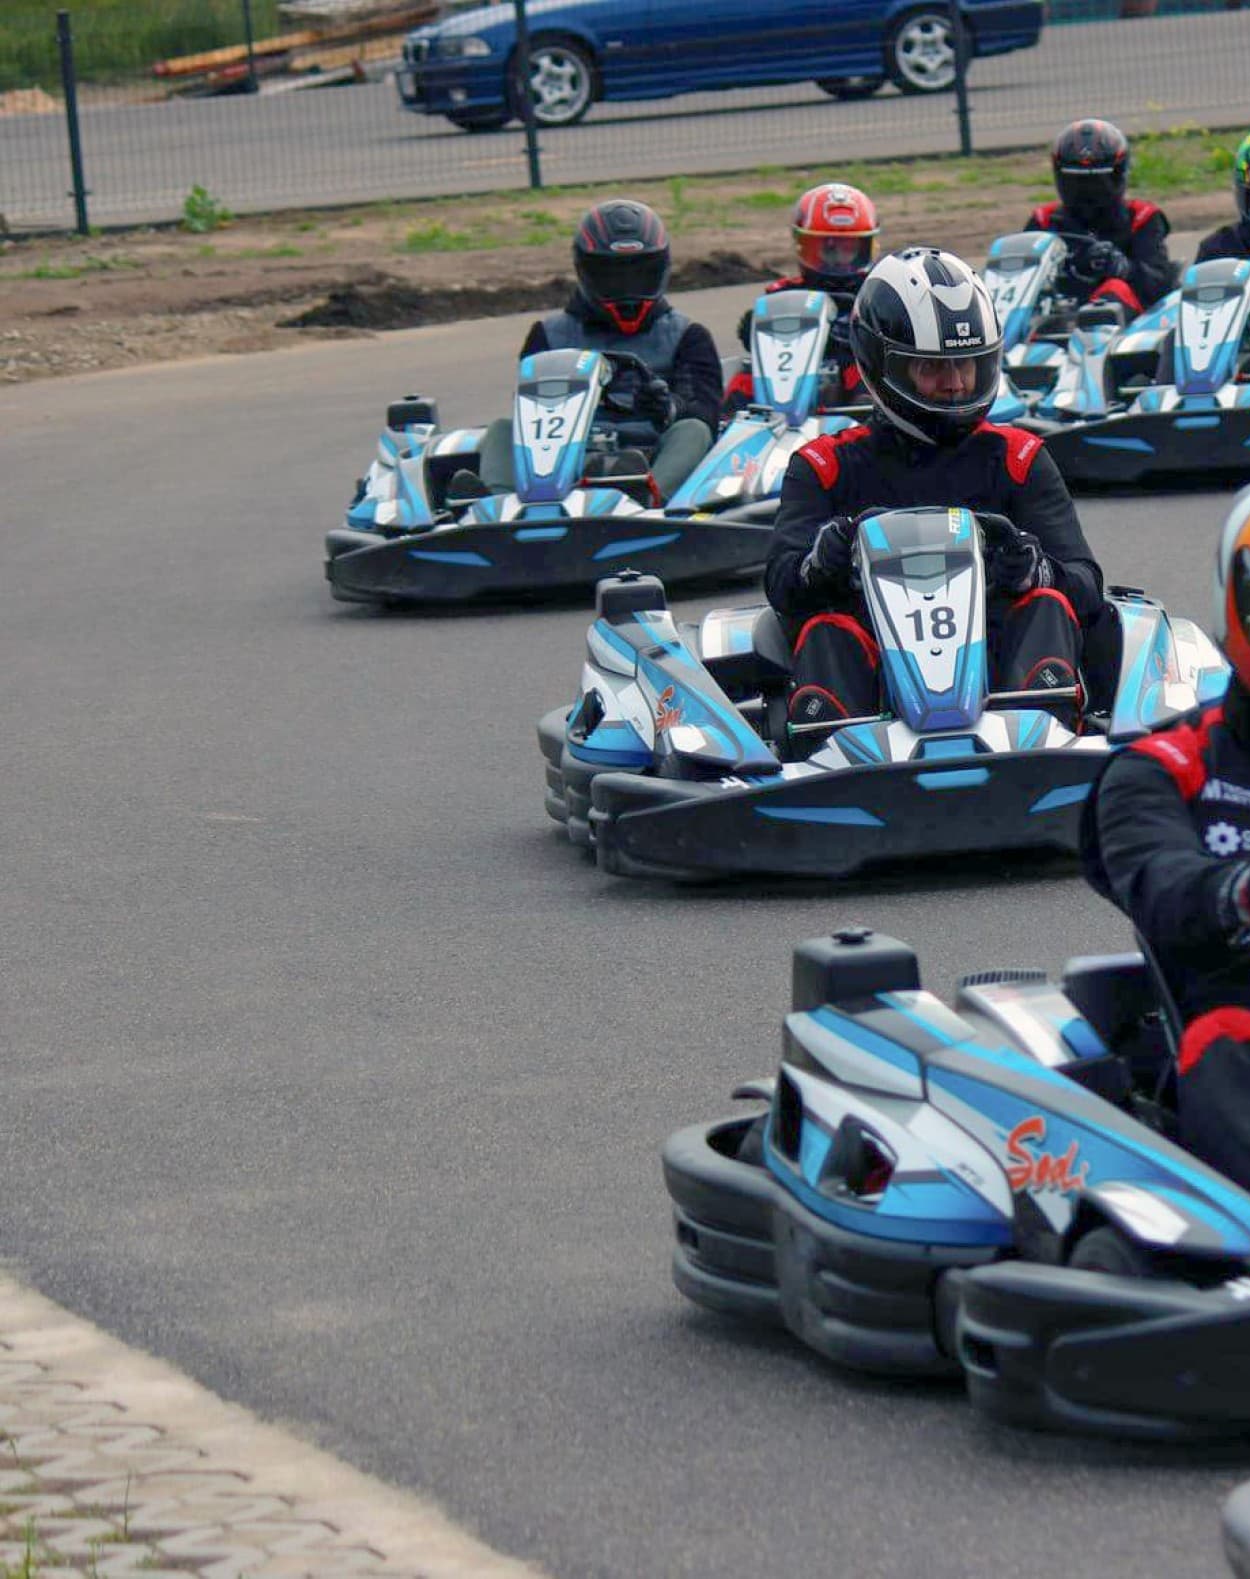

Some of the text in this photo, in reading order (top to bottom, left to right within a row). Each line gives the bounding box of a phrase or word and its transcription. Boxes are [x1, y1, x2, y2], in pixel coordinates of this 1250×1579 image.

[1200, 319, 1210, 338] 1
[944, 336, 982, 348] SHARK
[777, 351, 793, 372] 2
[530, 416, 564, 440] 12
[904, 606, 957, 642] 18
